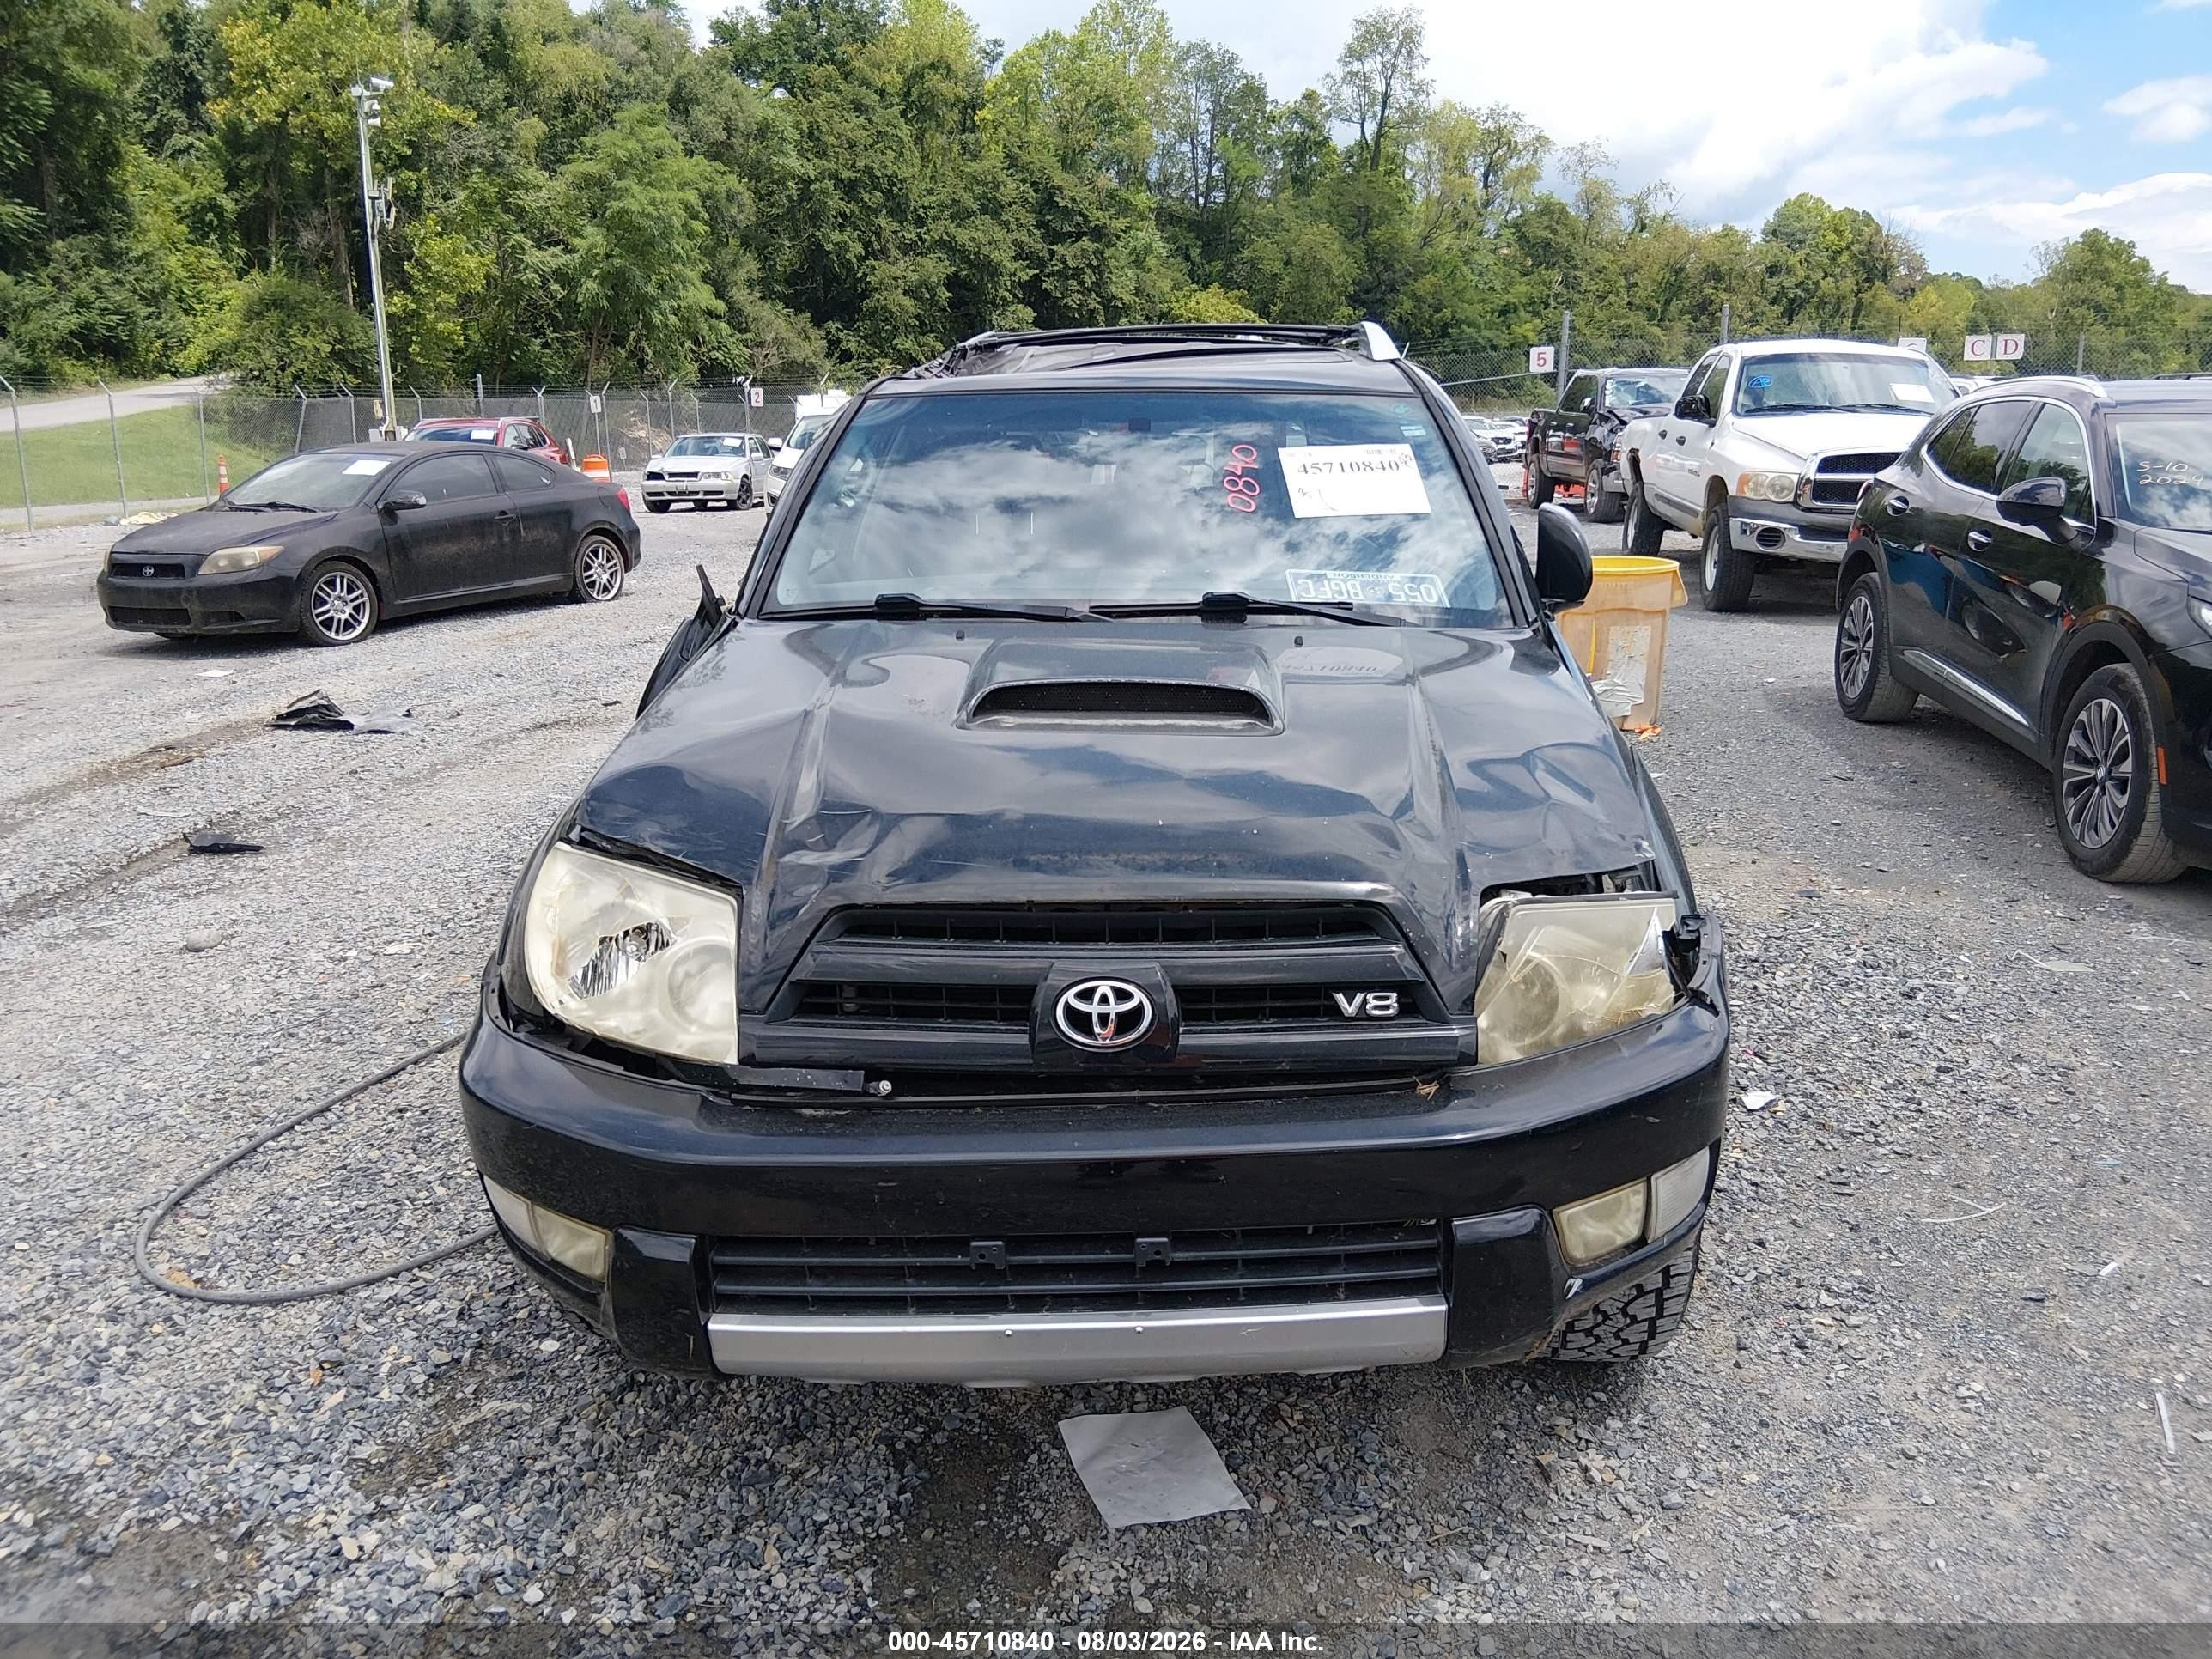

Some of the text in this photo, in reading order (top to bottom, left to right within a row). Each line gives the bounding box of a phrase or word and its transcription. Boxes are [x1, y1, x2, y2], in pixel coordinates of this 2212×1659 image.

[1971, 339, 1985, 356] C
[2002, 338, 2019, 355] D
[1537, 352, 1547, 367] 5
[754, 392, 761, 404] 2
[1297, 459, 1400, 475] 45710840
[1223, 444, 1261, 513] 0840
[2139, 474, 2204, 486] 2024
[1387, 582, 1440, 603] 055
[1332, 992, 1400, 1017] V8
